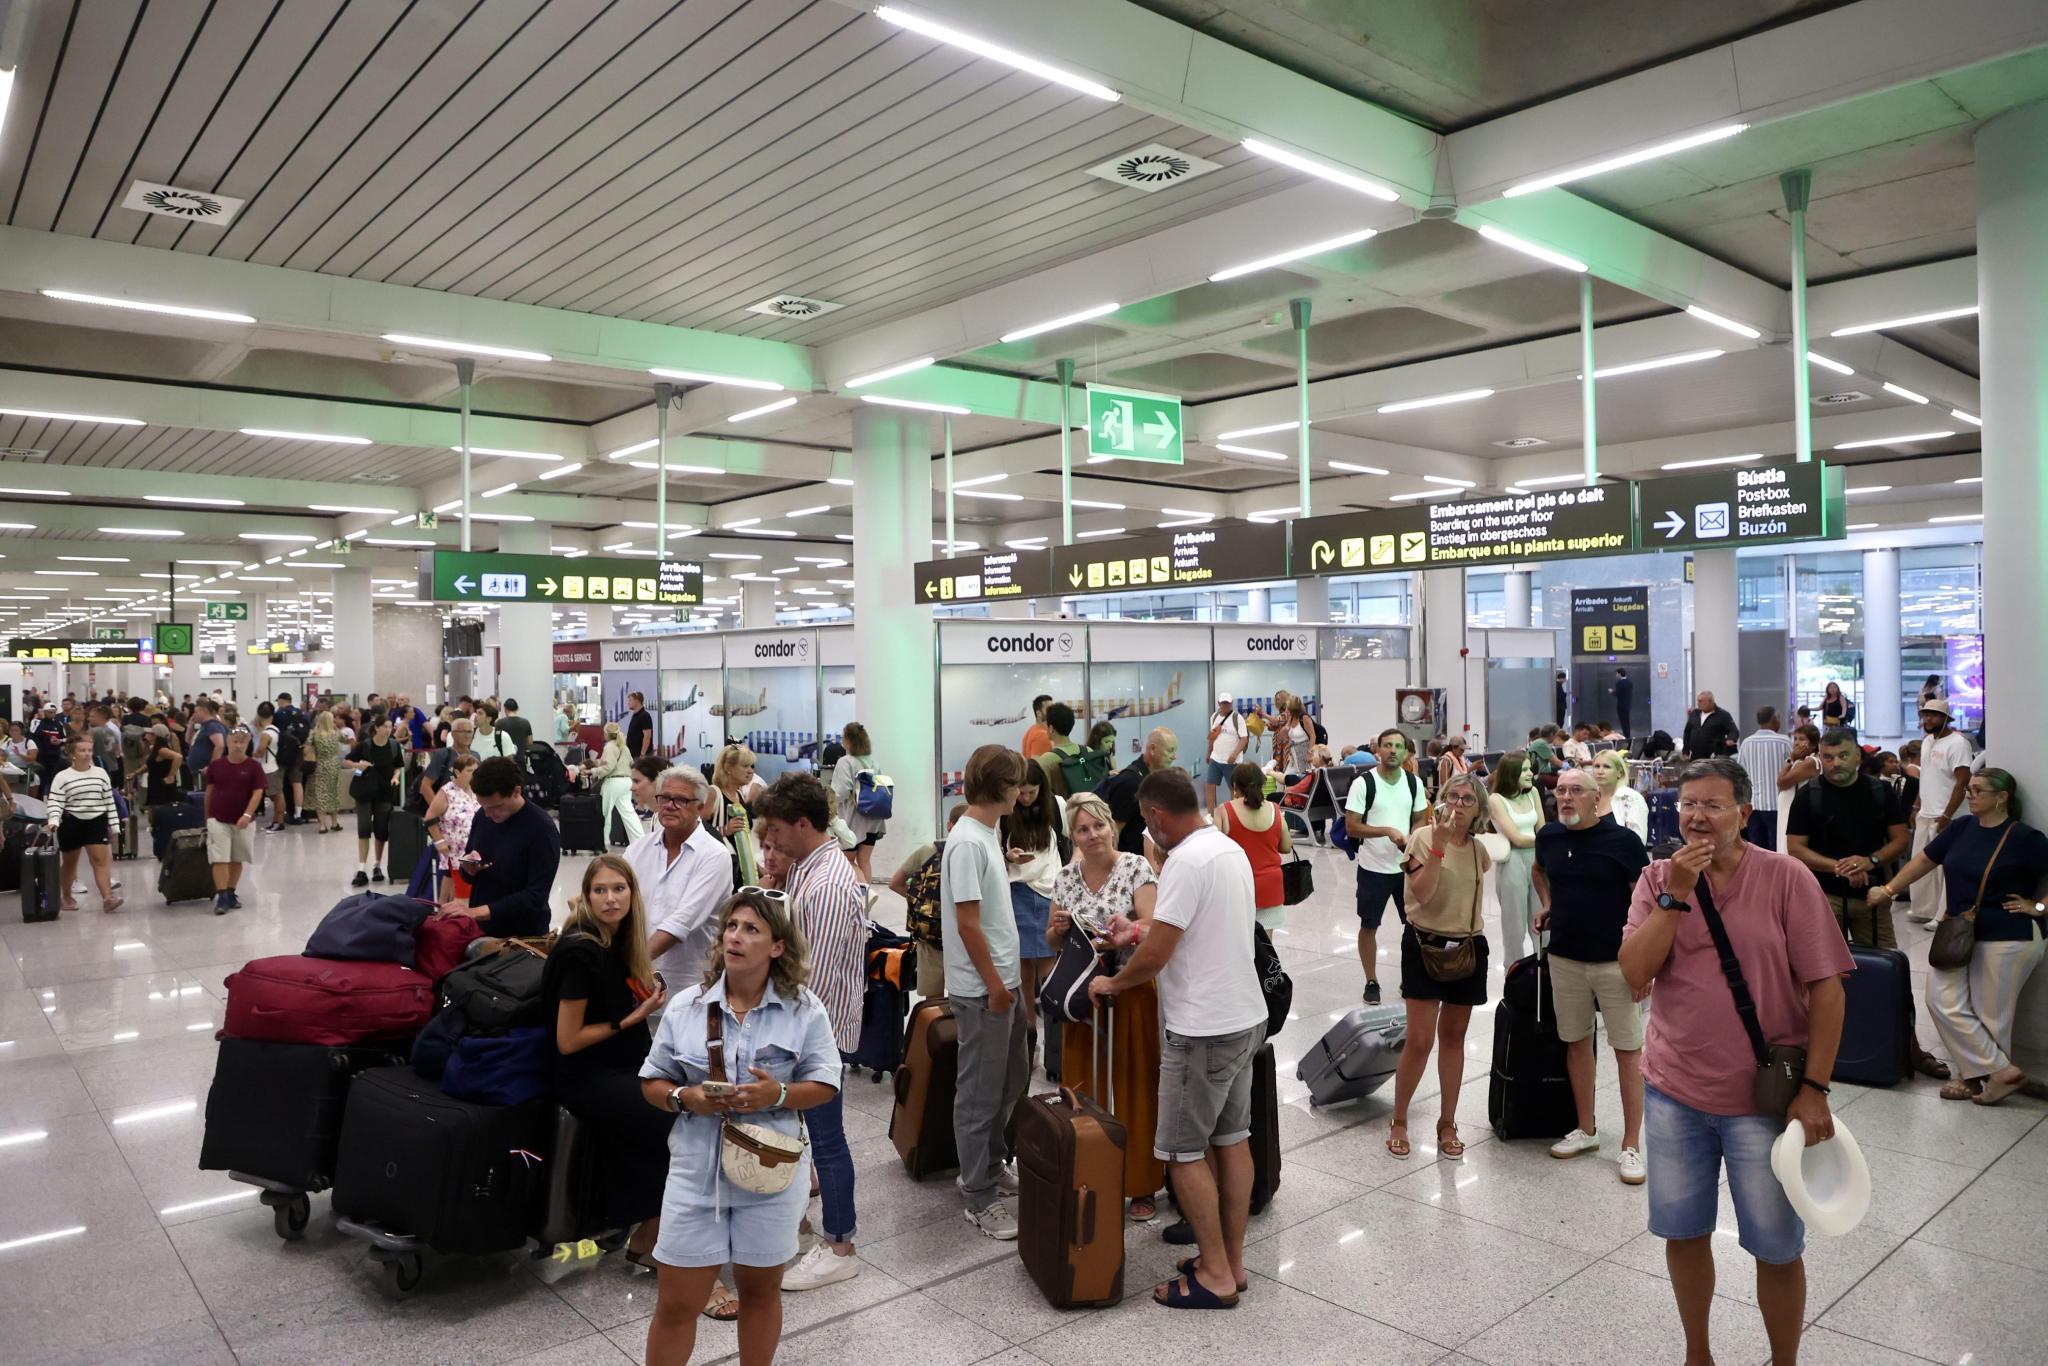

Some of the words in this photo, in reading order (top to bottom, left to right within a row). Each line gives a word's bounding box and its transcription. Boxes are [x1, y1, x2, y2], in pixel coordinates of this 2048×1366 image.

[1738, 468, 1786, 486] Bústia
[1738, 487, 1790, 502] Post-box
[1430, 498, 1514, 519] Embarcament
[1515, 494, 1535, 512] pel
[1537, 492, 1556, 510] pis
[1558, 491, 1575, 505] de
[1577, 488, 1604, 503] dalt
[1738, 502, 1807, 518] Briefkasten
[1430, 518, 1470, 532] Boarding
[1472, 518, 1483, 528] on
[1485, 515, 1500, 526] the
[1502, 513, 1529, 526] upper
[1531, 510, 1554, 522] floor
[1739, 519, 1787, 536] Buzón
[1173, 531, 1216, 546] Arribades
[1431, 532, 1466, 545] Einstieg
[1467, 531, 1479, 542] im
[1480, 526, 1547, 541] obergeschoss
[1173, 545, 1199, 557] Arrivals
[1431, 546, 1491, 560] Embarque
[1493, 544, 1509, 555] en
[1511, 541, 1522, 554] la
[1524, 539, 1564, 556] planta
[1567, 533, 1624, 551] superior
[659, 561, 701, 574] Arribades
[1174, 556, 1199, 568] Ankunft
[1174, 568, 1213, 582] Llegadas
[659, 591, 697, 603] Llegadas
[984, 583, 1022, 596] Información
[1575, 597, 1608, 606] Arribades
[1613, 603, 1645, 612] Llegadas
[755, 639, 796, 658] condor
[988, 632, 1054, 652] condor
[1247, 634, 1295, 651] condor
[574, 653, 592, 662] SERVICE
[614, 647, 643, 662] condor
